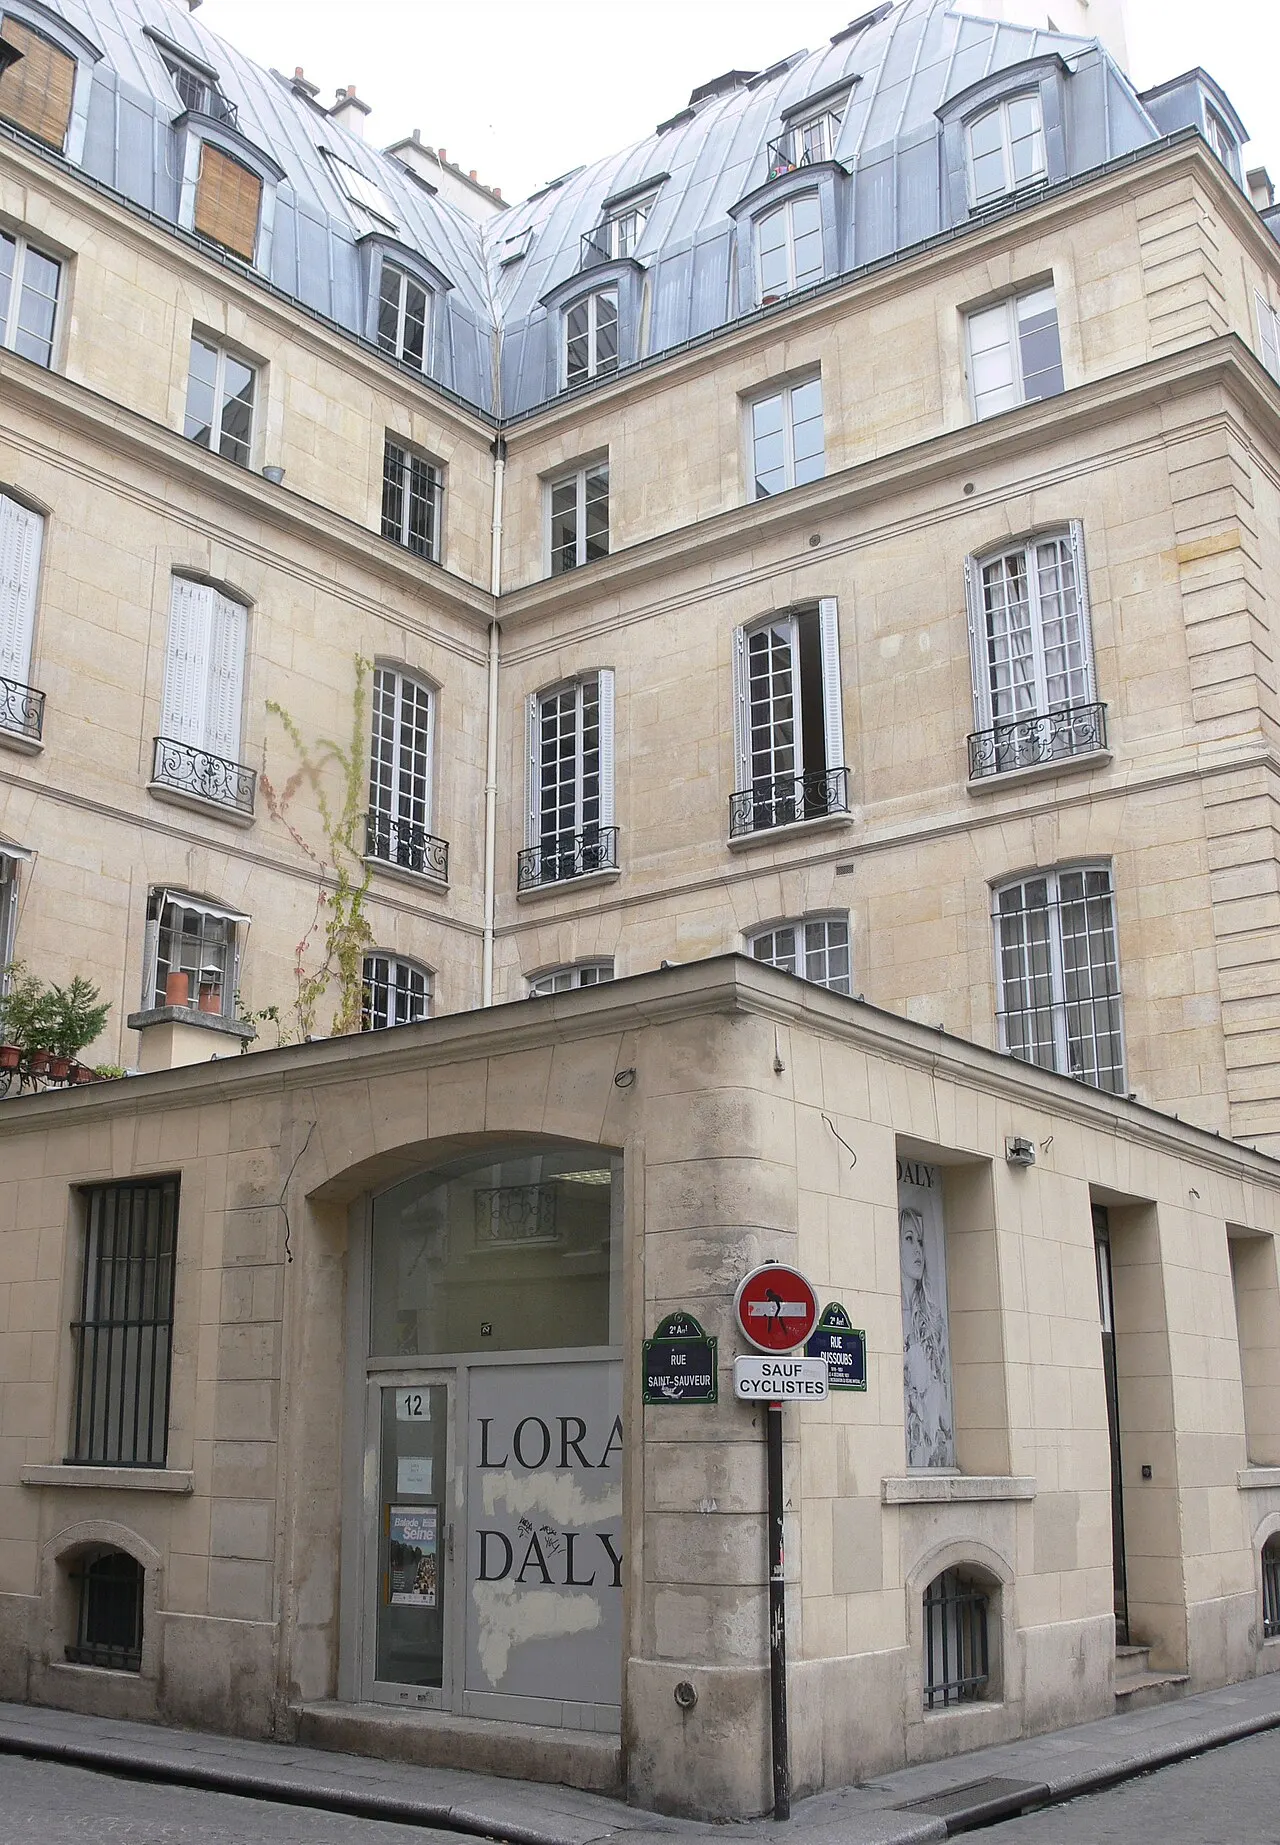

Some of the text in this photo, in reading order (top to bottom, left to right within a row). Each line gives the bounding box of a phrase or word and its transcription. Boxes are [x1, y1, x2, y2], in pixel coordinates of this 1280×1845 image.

[830, 1335, 843, 1349] RUE
[670, 1354, 687, 1366] RUE
[761, 1363, 803, 1377] SAUF
[648, 1374, 711, 1387] SAINT-SAUVEUR
[739, 1379, 825, 1394] CYCLISTES
[404, 1394, 423, 1416] 12
[394, 1517, 419, 1527] Balade
[402, 1526, 433, 1540] Seine
